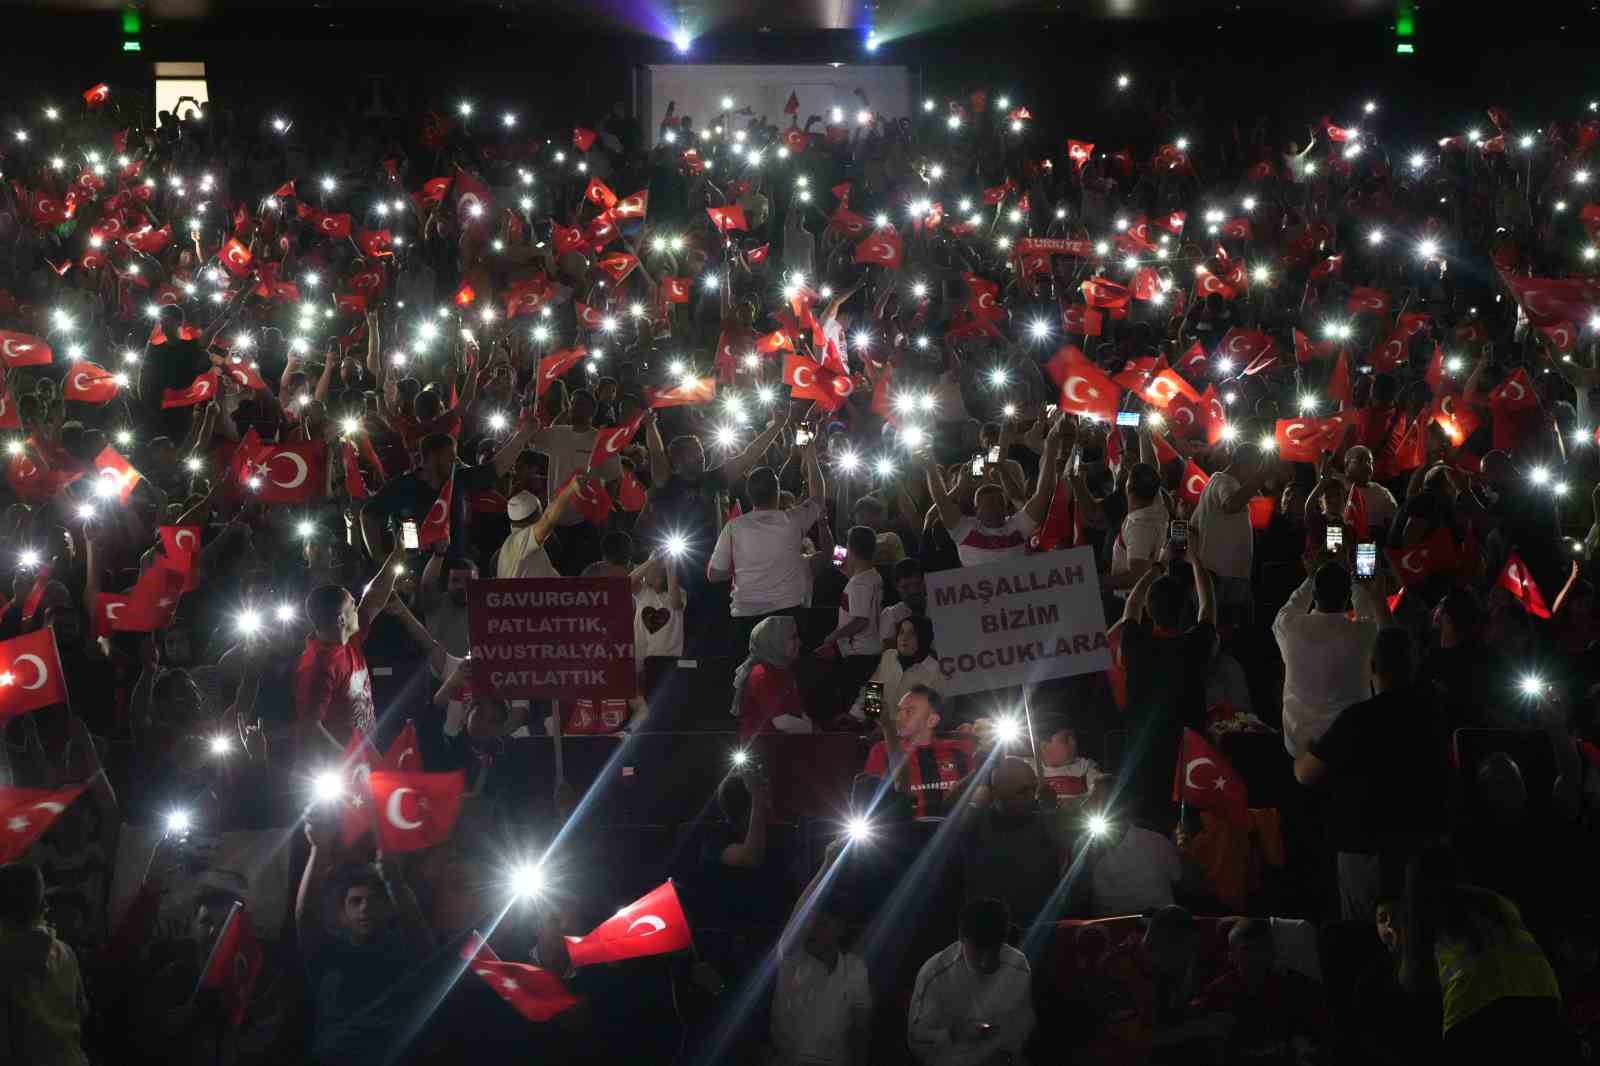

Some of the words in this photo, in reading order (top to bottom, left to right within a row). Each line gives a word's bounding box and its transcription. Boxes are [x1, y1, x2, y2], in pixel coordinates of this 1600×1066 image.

[935, 564, 1085, 607] MAŞALLAH
[485, 591, 609, 608] GAVURGAYI
[487, 617, 608, 635] PATLATTIK,
[981, 603, 1060, 634] BİZİM
[939, 631, 1108, 681] ÇOCUKLARA
[490, 669, 608, 689] ÇATLATTIK
